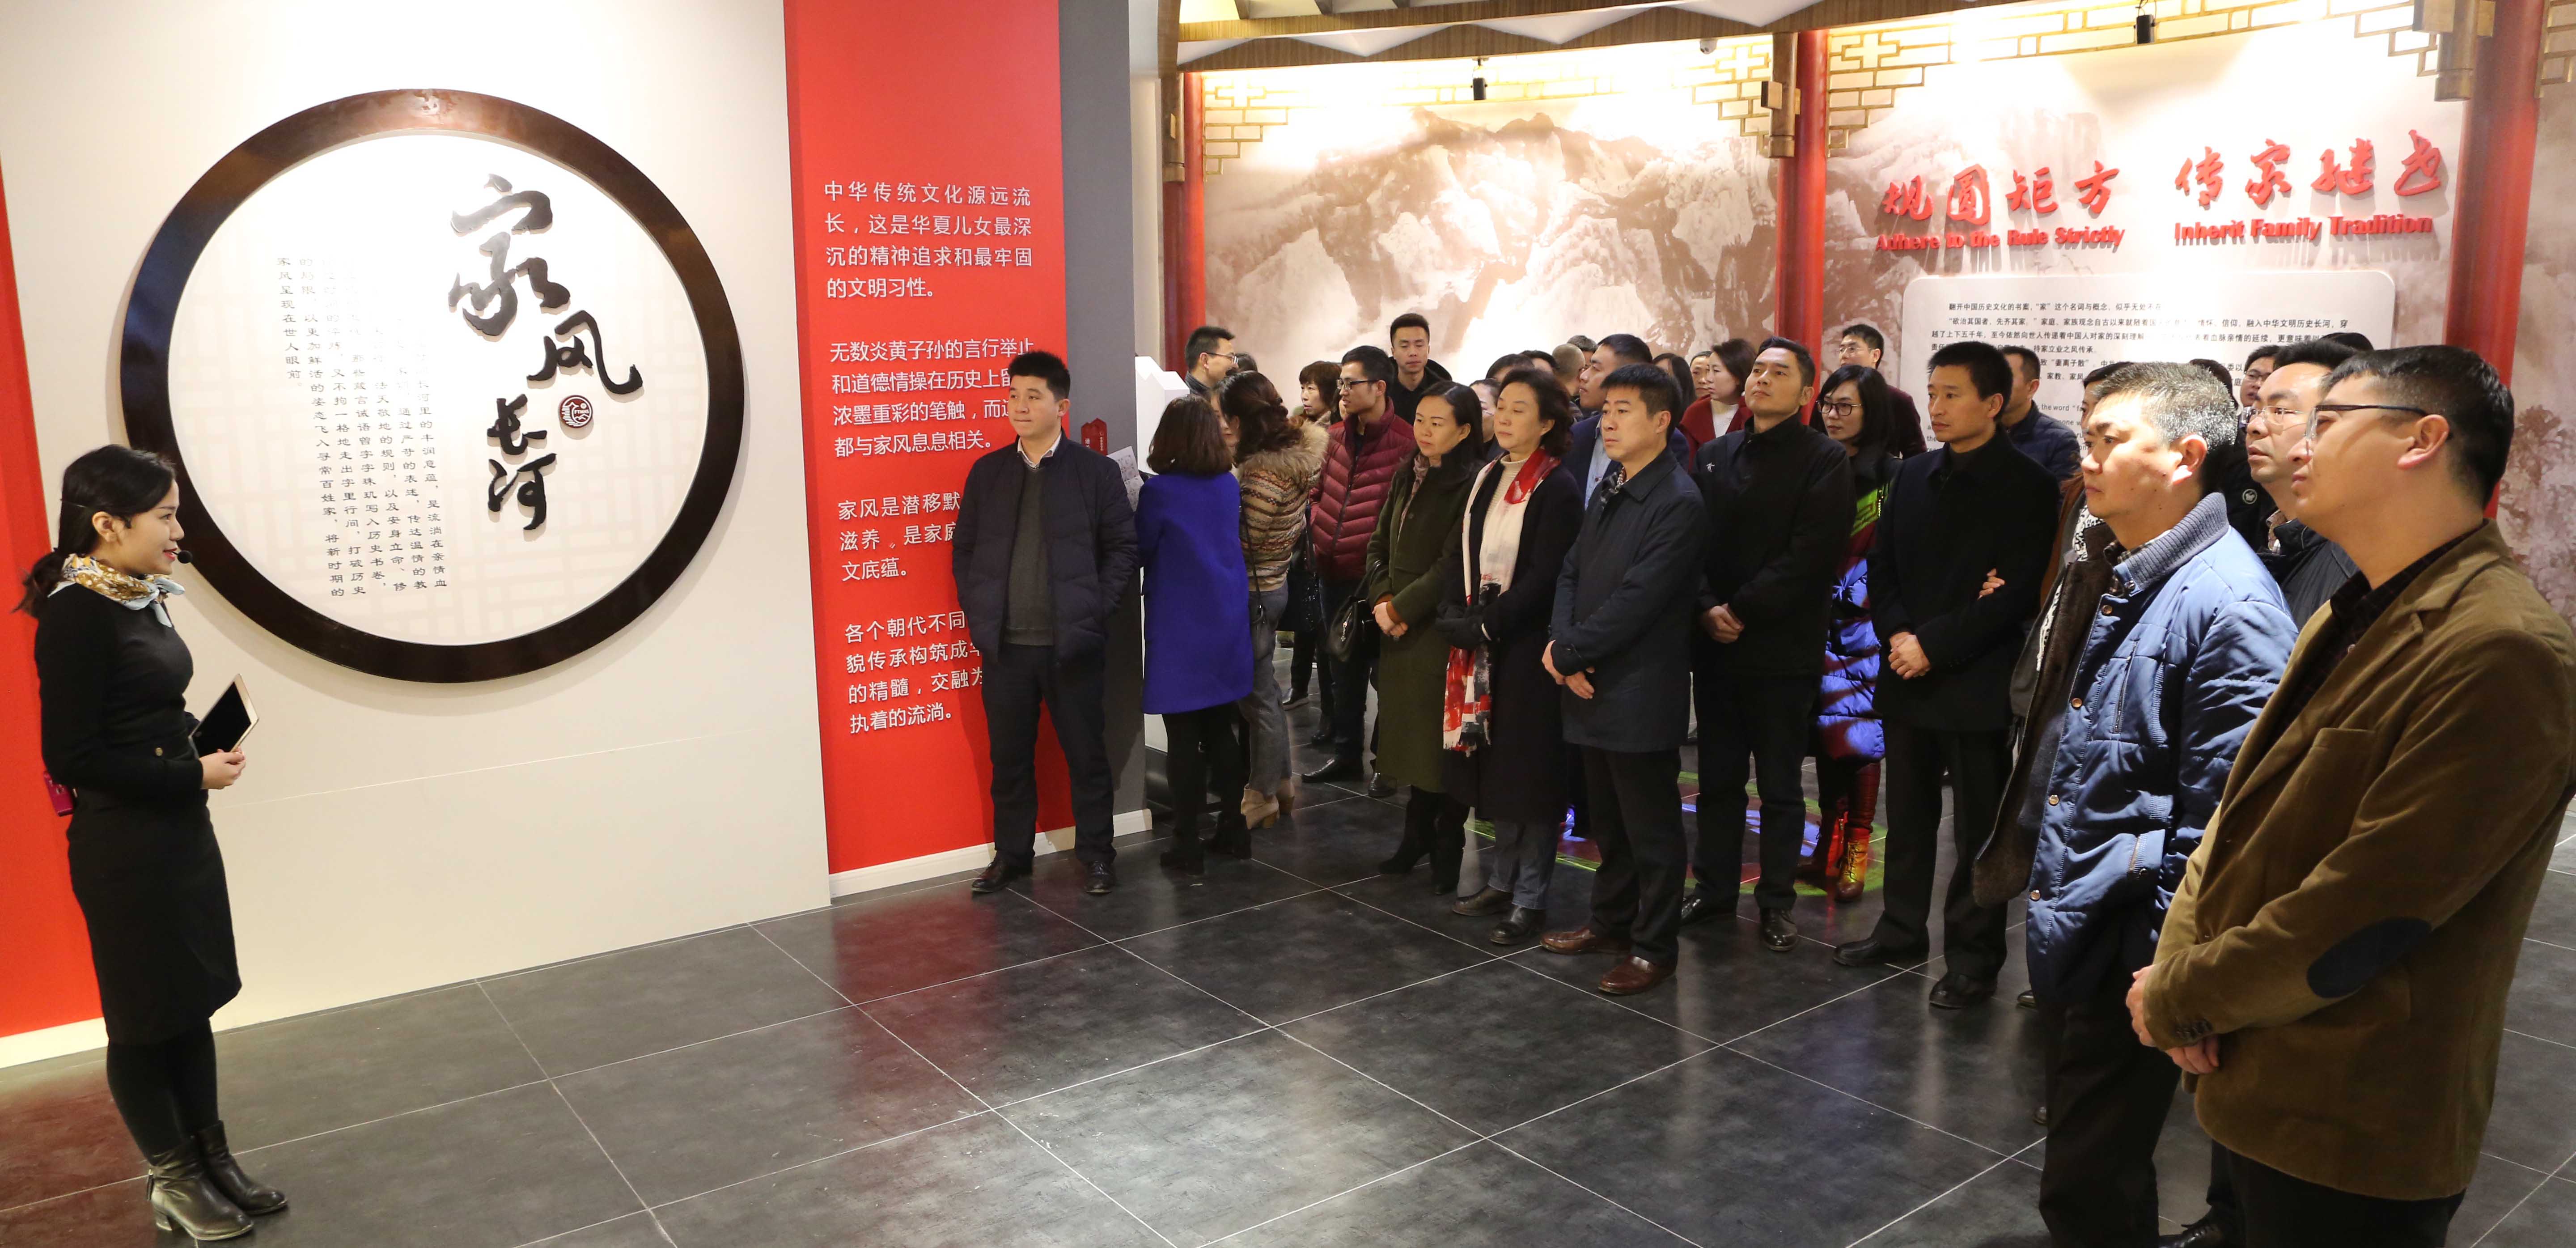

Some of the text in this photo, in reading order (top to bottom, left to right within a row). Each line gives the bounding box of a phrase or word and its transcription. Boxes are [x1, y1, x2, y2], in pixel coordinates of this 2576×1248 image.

[824, 180, 1031, 207] 中华传统文化源远流
[1875, 225, 2126, 251] Adhere to the Rule Strictly
[2174, 213, 2433, 241] Inherit Family Tradition
[825, 245, 1033, 267] 沉的精神追求和最牢固
[826, 277, 934, 299] 的文明习性。
[830, 337, 1034, 363] 无数炎黄子孙的言行举止
[834, 429, 991, 458] 都与家风息息相关。
[838, 491, 960, 521] 家风是潜移默
[844, 610, 966, 644] 各个朝代不同
[850, 702, 952, 734] 执着的流淌。
